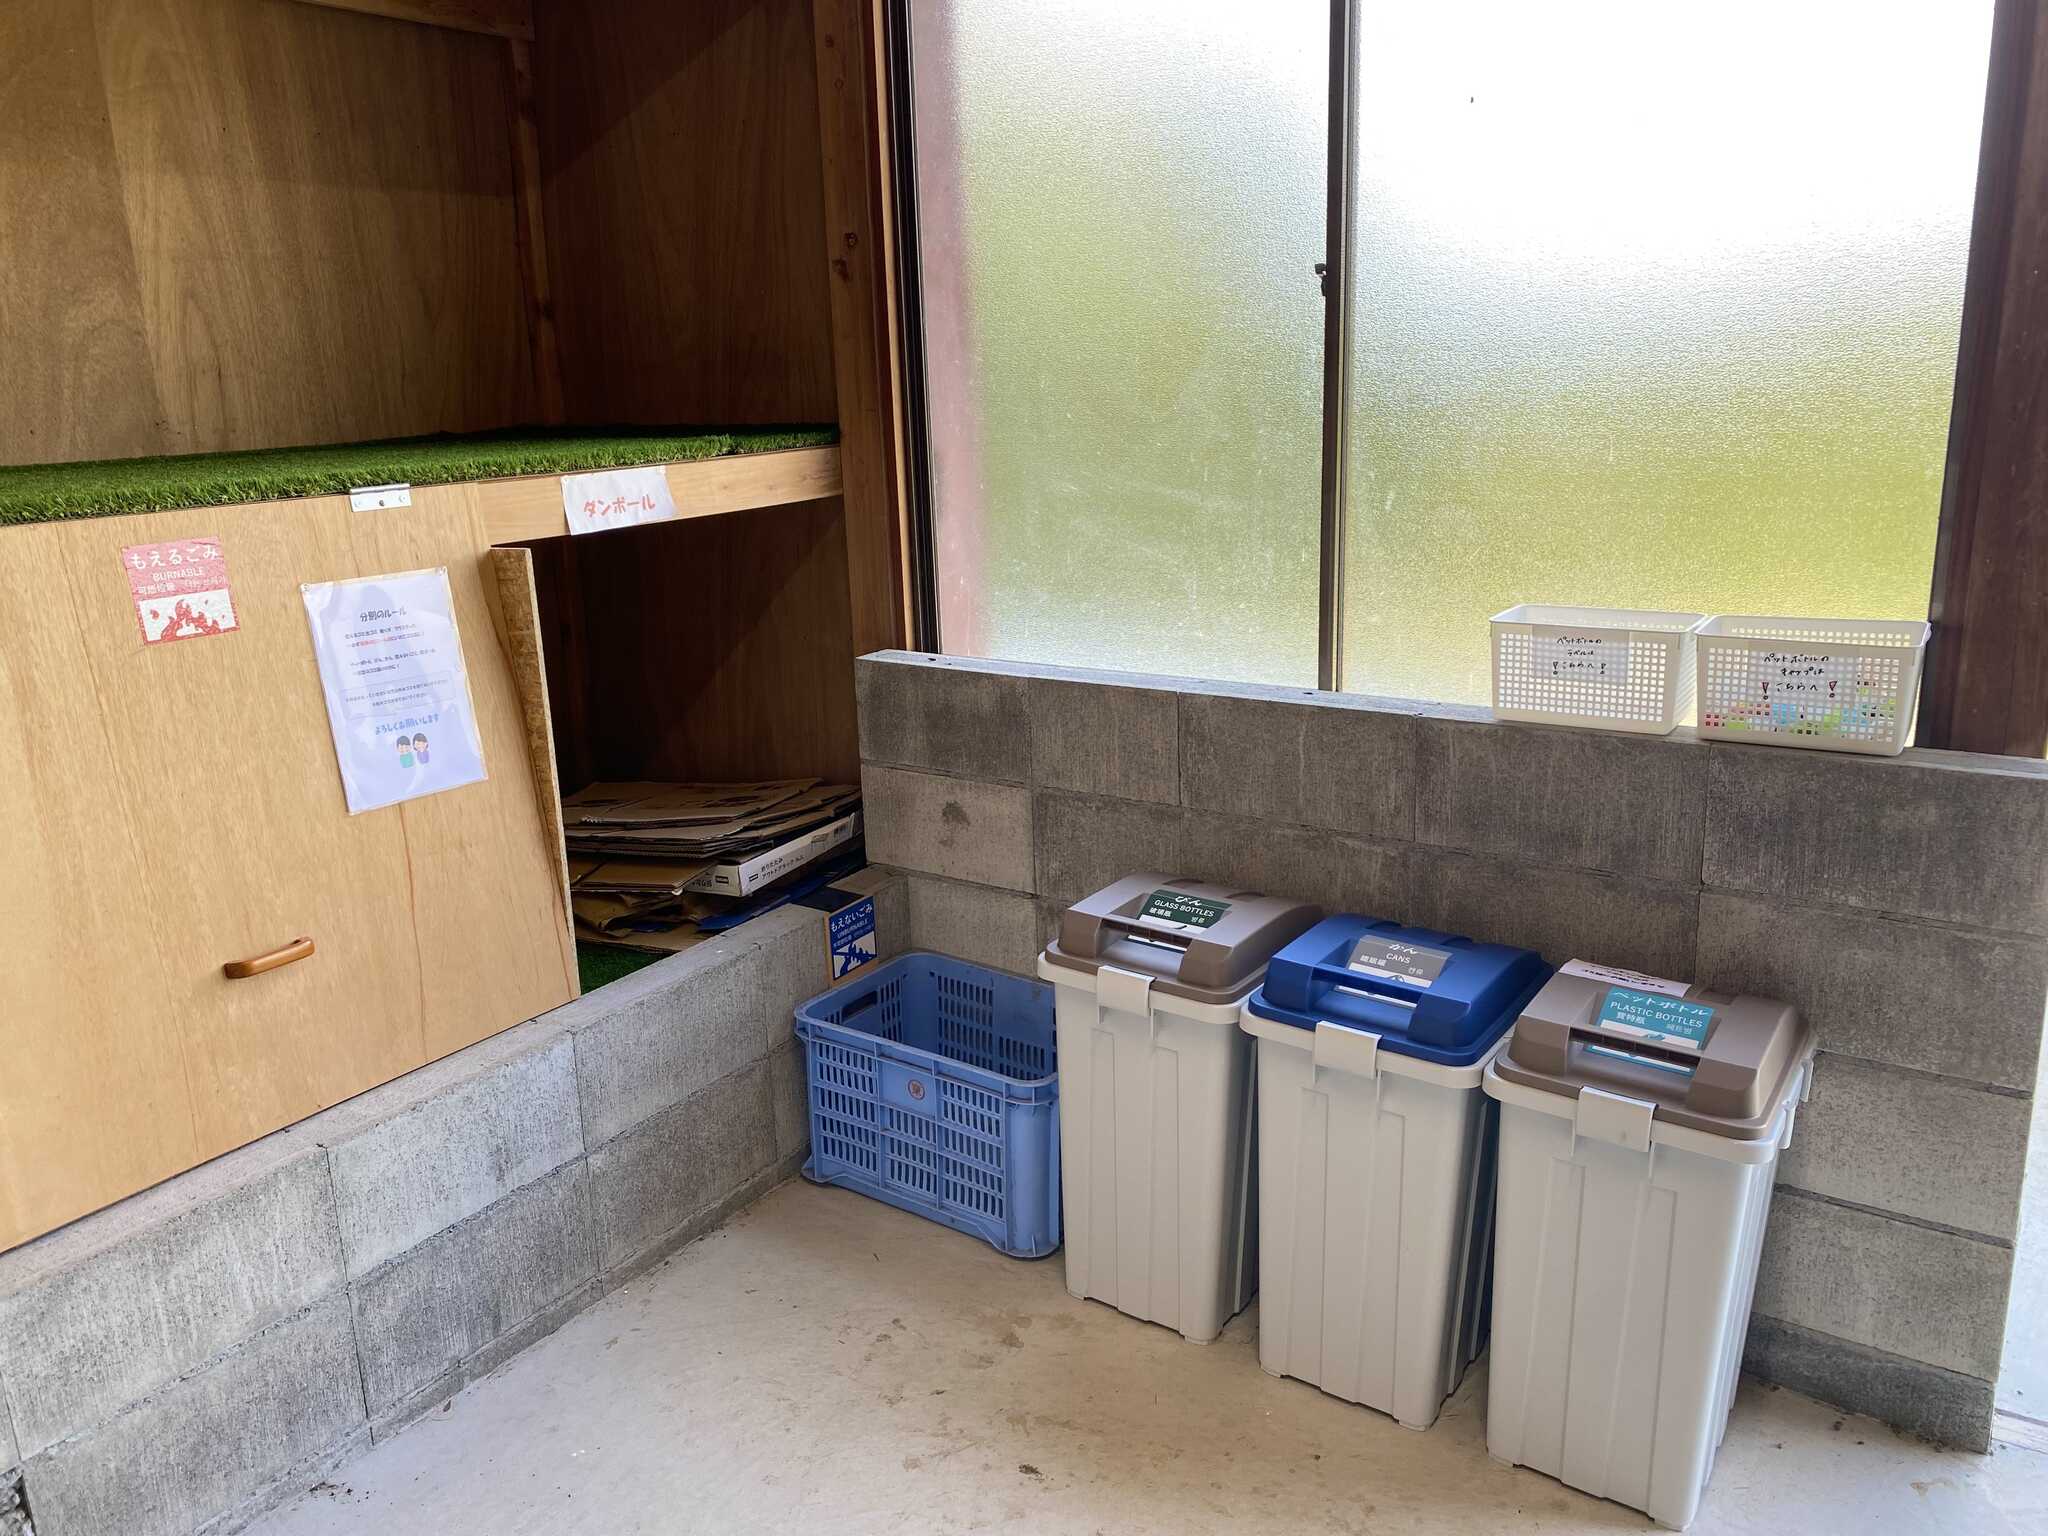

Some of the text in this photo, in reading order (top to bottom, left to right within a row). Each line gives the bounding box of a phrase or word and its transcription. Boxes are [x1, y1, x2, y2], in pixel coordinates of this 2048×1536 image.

[583, 494, 656, 518] ダンボール
[130, 545, 218, 570] もえるごみ
[152, 567, 205, 582] BURNABLE
[359, 606, 408, 622] 分別のルール
[1764, 653, 1829, 664] ペットボトルの
[1780, 666, 1825, 677] キャップは
[375, 713, 439, 735] よろしくお願いします
[1154, 899, 1215, 917] GLASS BOTTLES
[1174, 895, 1203, 907] びん
[832, 903, 872, 932] もえないごみ
[1389, 943, 1418, 955] かん
[1386, 952, 1411, 964] CANS
[1610, 1001, 1703, 1028] PLASTIC BOTTLES
